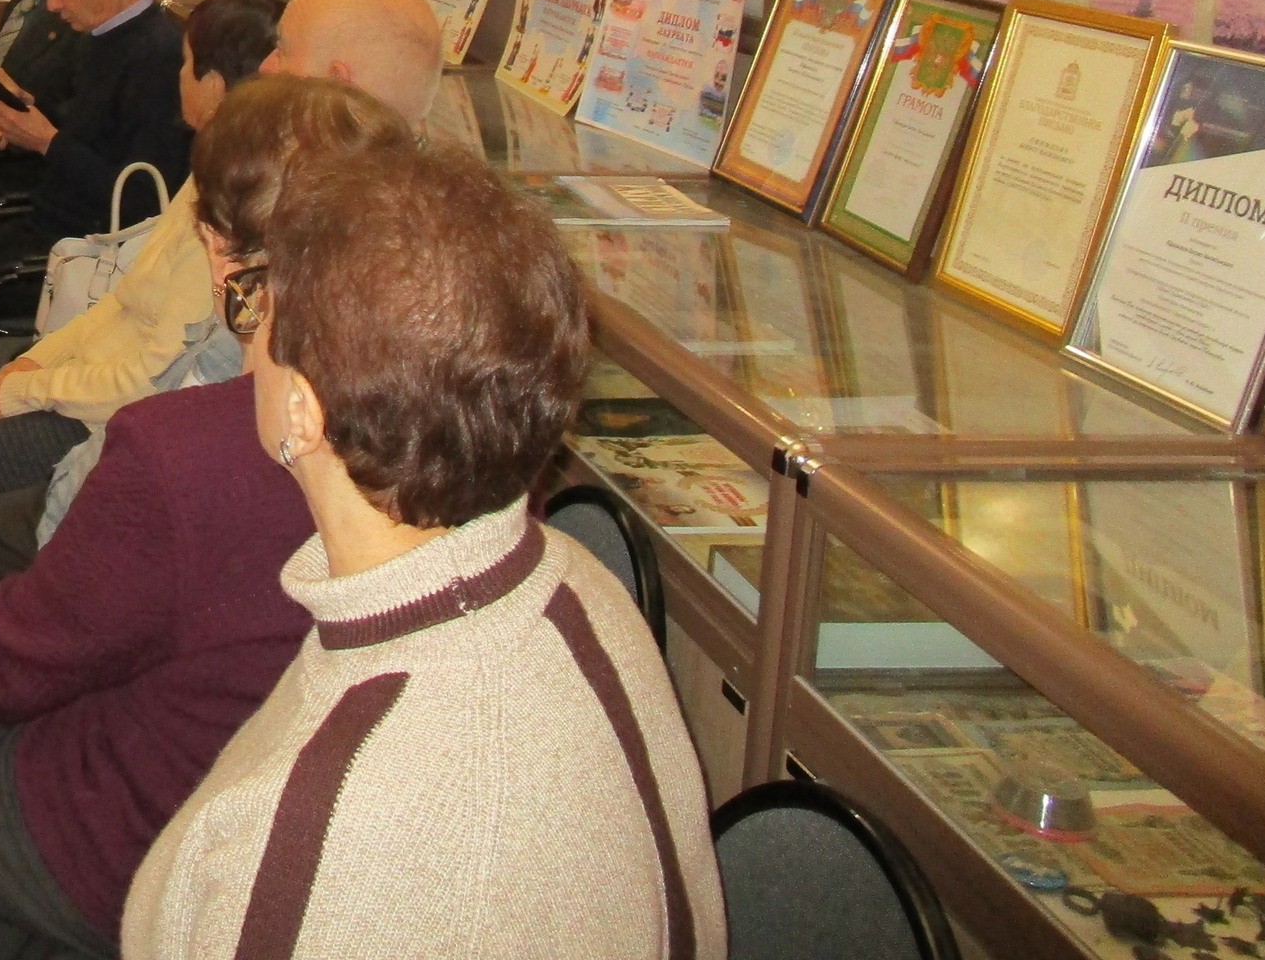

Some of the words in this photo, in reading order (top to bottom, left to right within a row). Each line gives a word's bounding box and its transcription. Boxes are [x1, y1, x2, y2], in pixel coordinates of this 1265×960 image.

[657, 11, 700, 31] ДИПЛОМ
[897, 93, 944, 120] ГРАМОТА
[1164, 174, 1265, 226] ДИПЛОМ
